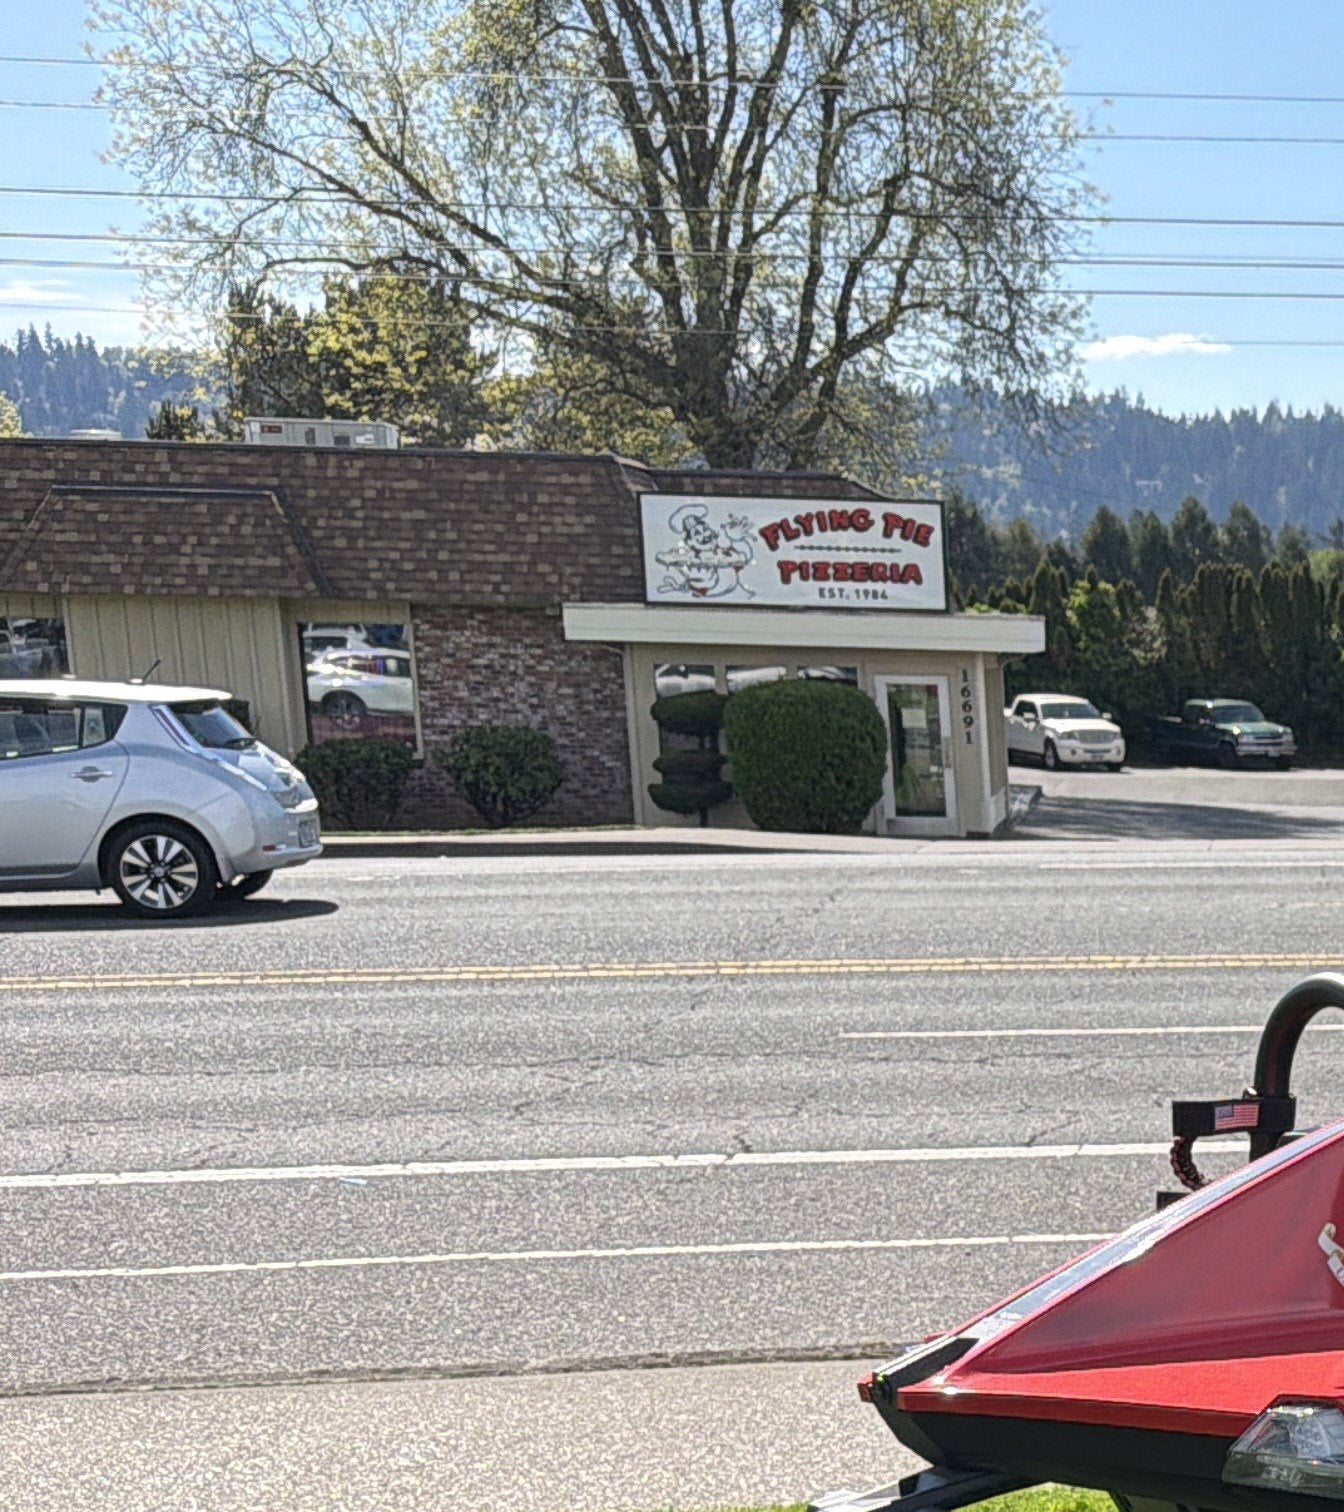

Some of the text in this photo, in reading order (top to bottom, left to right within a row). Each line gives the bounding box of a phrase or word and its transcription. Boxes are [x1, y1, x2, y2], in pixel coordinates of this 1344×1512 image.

[758, 508, 935, 551] FLYING PIE
[777, 559, 923, 585] PIZZERIA
[818, 586, 888, 601] EST. 1984
[960, 668, 974, 745] 16691
